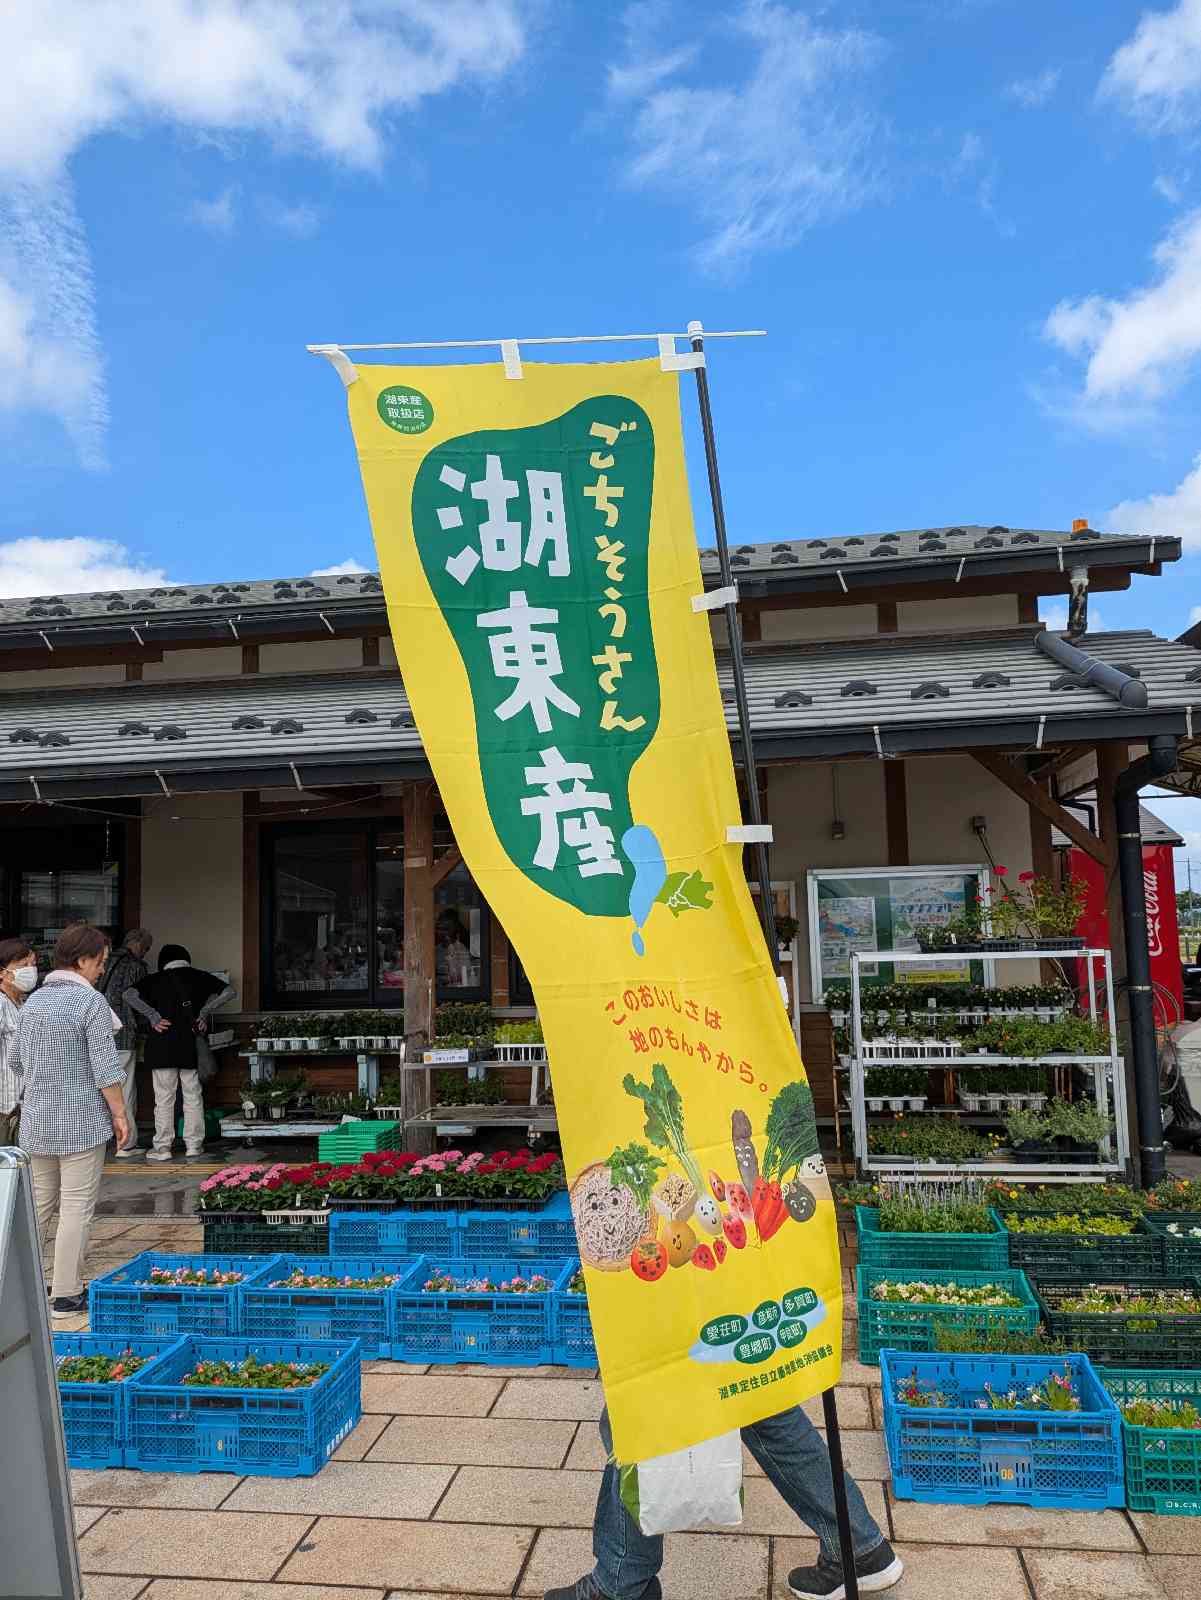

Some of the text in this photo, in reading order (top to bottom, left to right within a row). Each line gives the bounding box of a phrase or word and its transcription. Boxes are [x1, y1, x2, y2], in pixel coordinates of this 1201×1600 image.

[383, 394, 423, 406] 湖東産
[387, 407, 425, 420] 取扱店
[583, 420, 646, 732] ごちそうさん
[436, 454, 624, 878] 湖東産
[605, 984, 723, 1031] このおいしさは
[628, 1026, 768, 1093] 地のもんやから。
